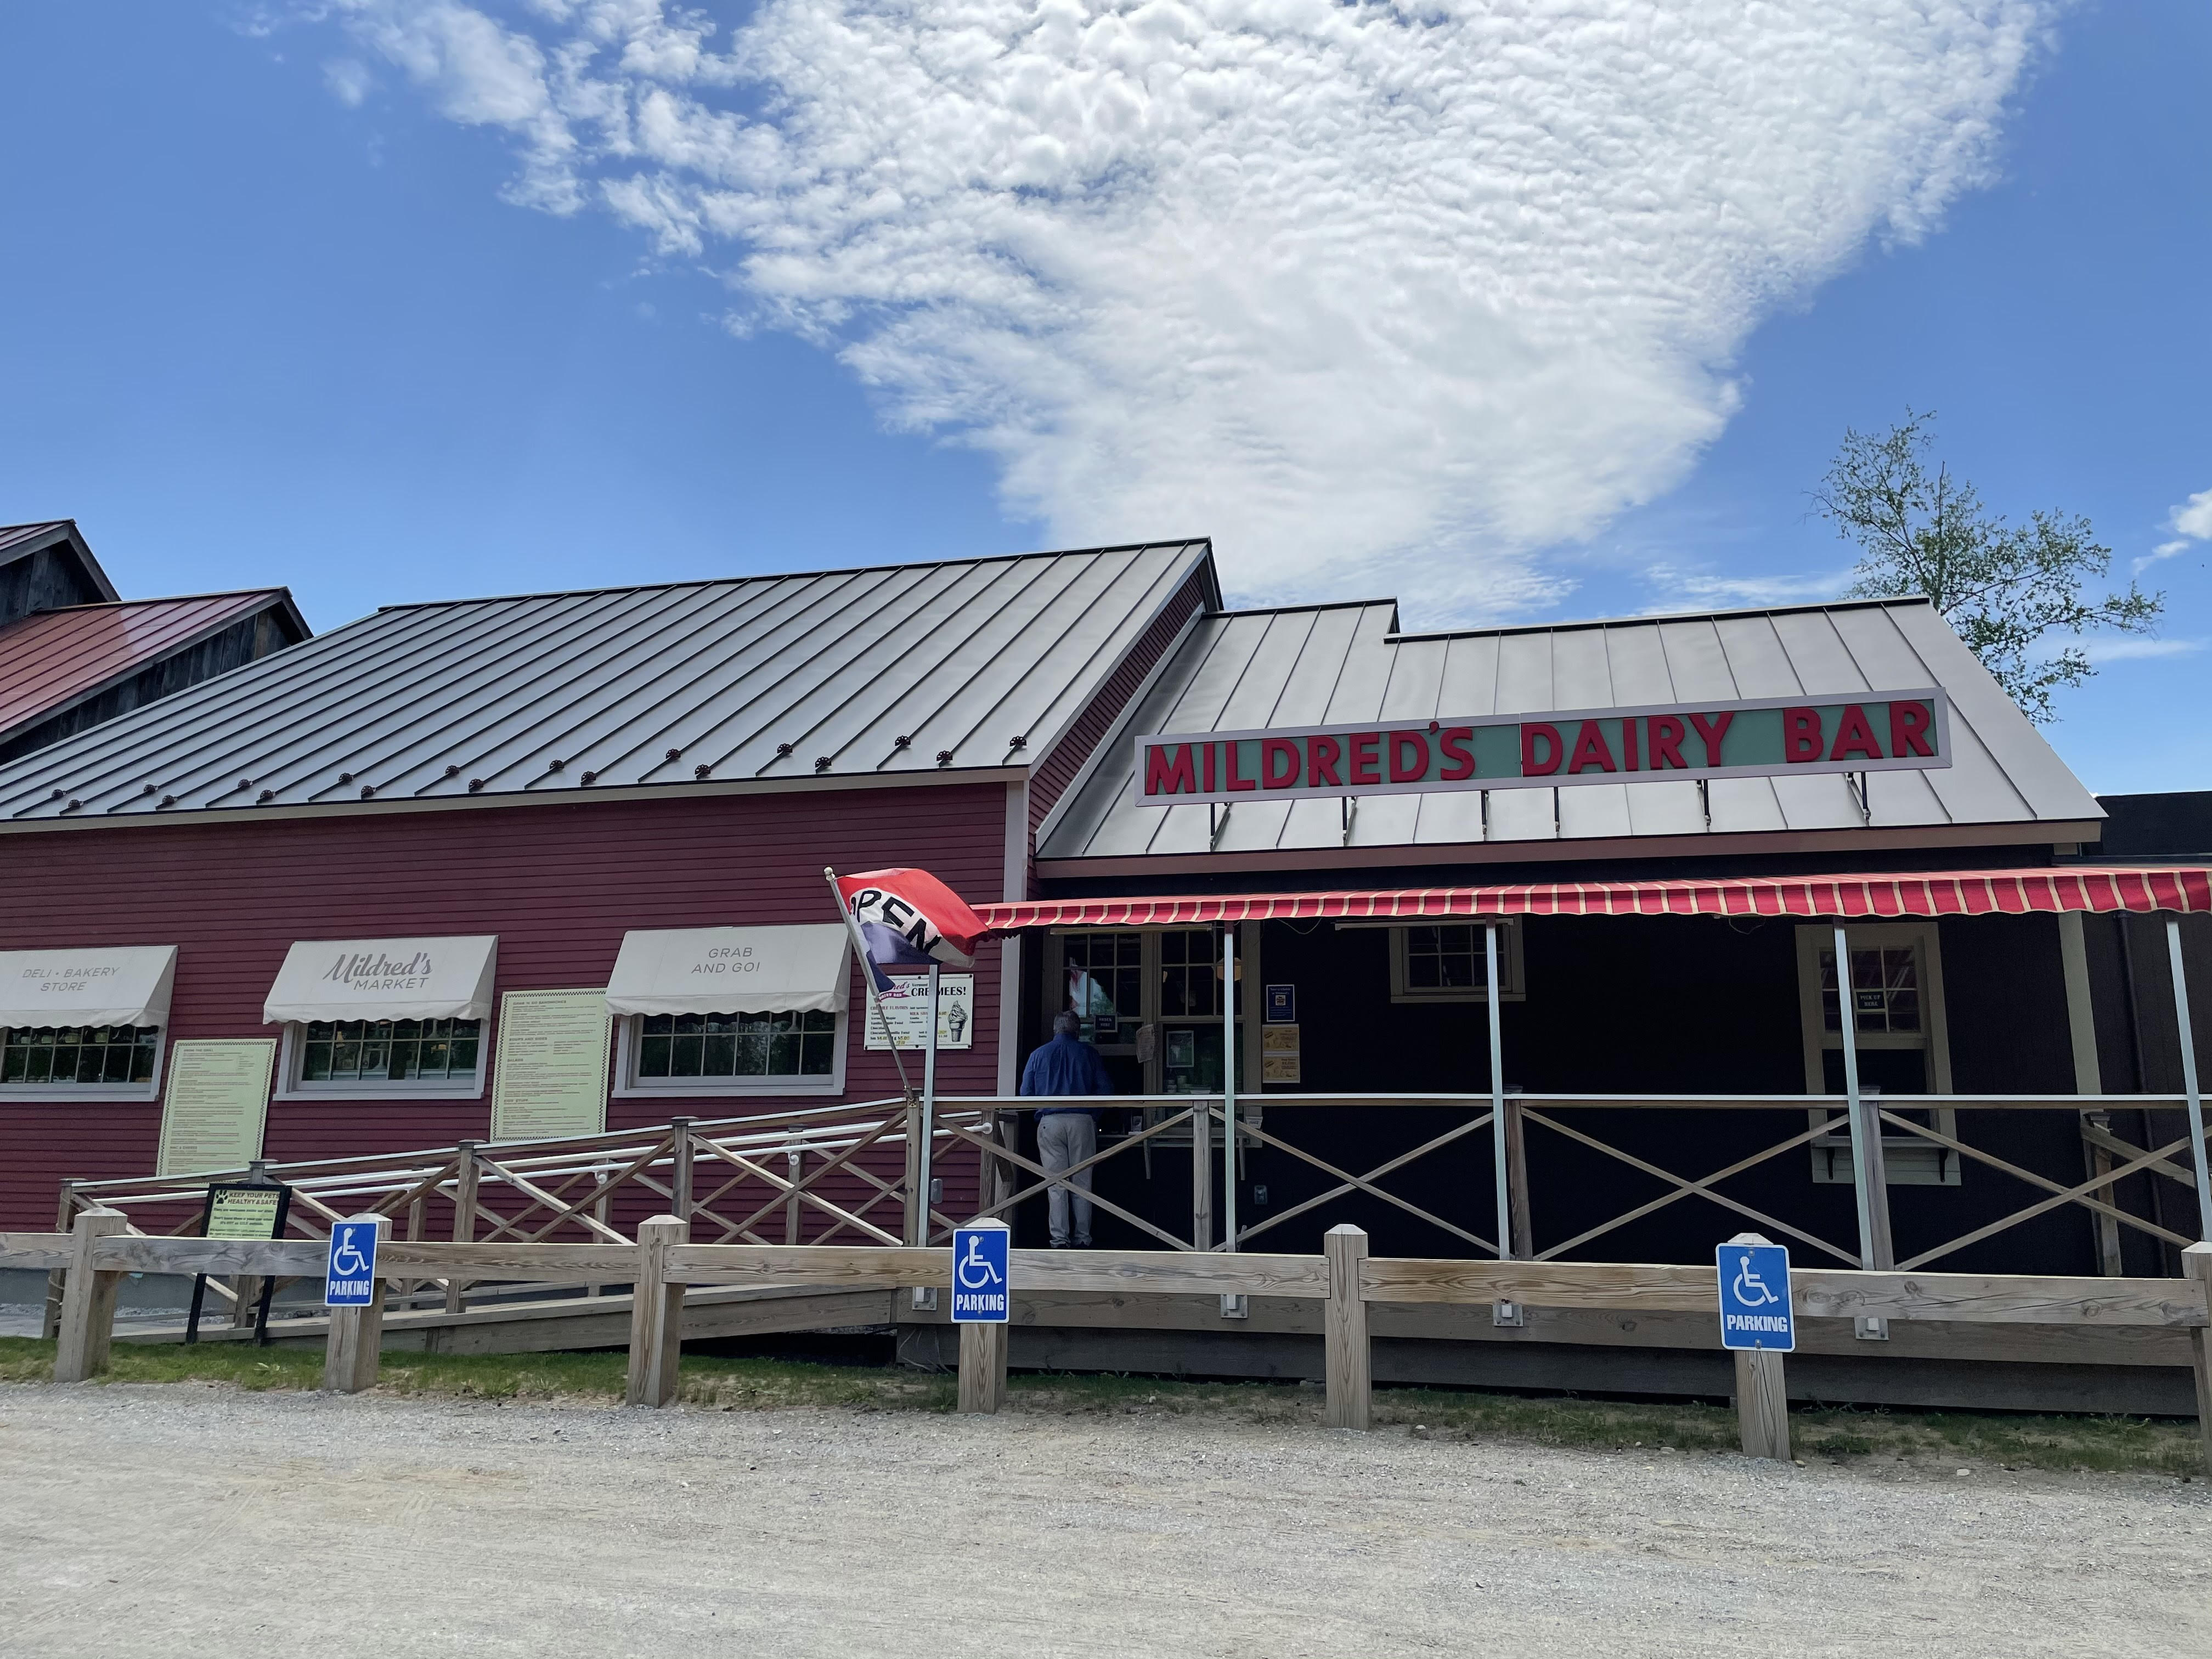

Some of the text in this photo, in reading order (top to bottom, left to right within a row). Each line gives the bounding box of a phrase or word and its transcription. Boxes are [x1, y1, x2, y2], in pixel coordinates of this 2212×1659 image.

[1146, 702, 1934, 794] MILDRED'S DAIRY BAR
[708, 947, 752, 958] GRAB
[22, 967, 120, 978] DELI BAKERY
[323, 952, 433, 984] Mildred's
[691, 963, 726, 974] AND
[41, 981, 87, 991] STORE
[354, 978, 429, 990] MARKET
[330, 1280, 369, 1296] PARKING
[956, 1294, 1004, 1311] PARKING
[1726, 1314, 1788, 1333] PARKING
